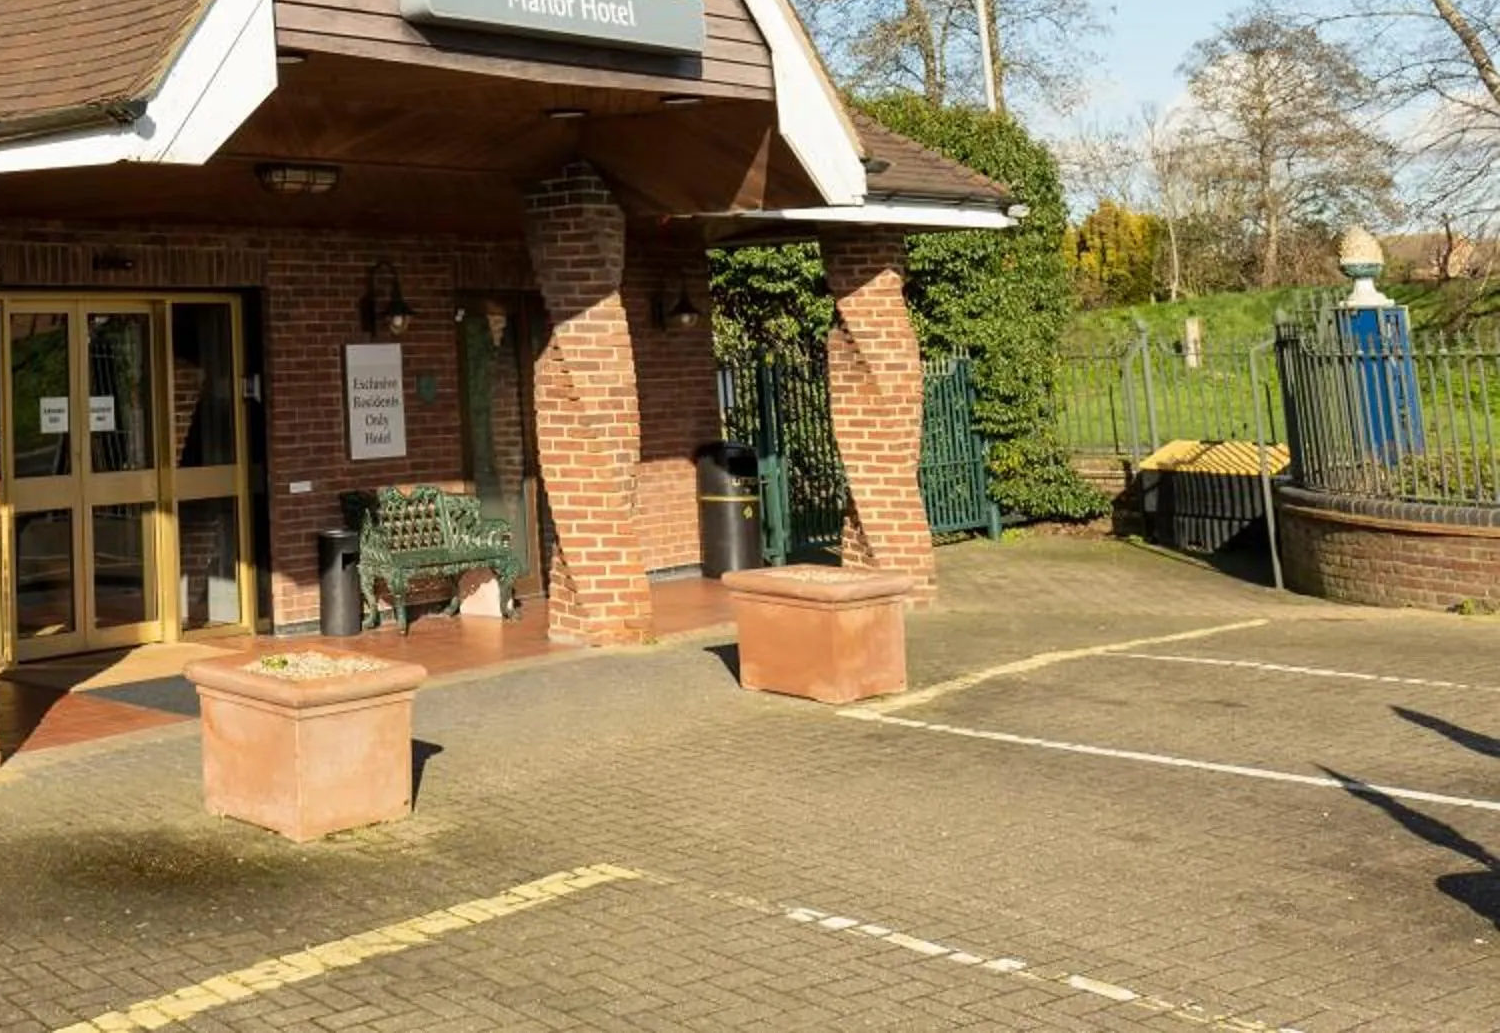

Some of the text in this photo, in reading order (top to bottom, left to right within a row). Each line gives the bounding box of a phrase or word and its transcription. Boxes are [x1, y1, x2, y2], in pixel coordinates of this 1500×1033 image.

[353, 376, 398, 390] Exclusive
[353, 395, 400, 409] Residents
[365, 412, 389, 430] Only
[365, 430, 392, 445] Hotel
